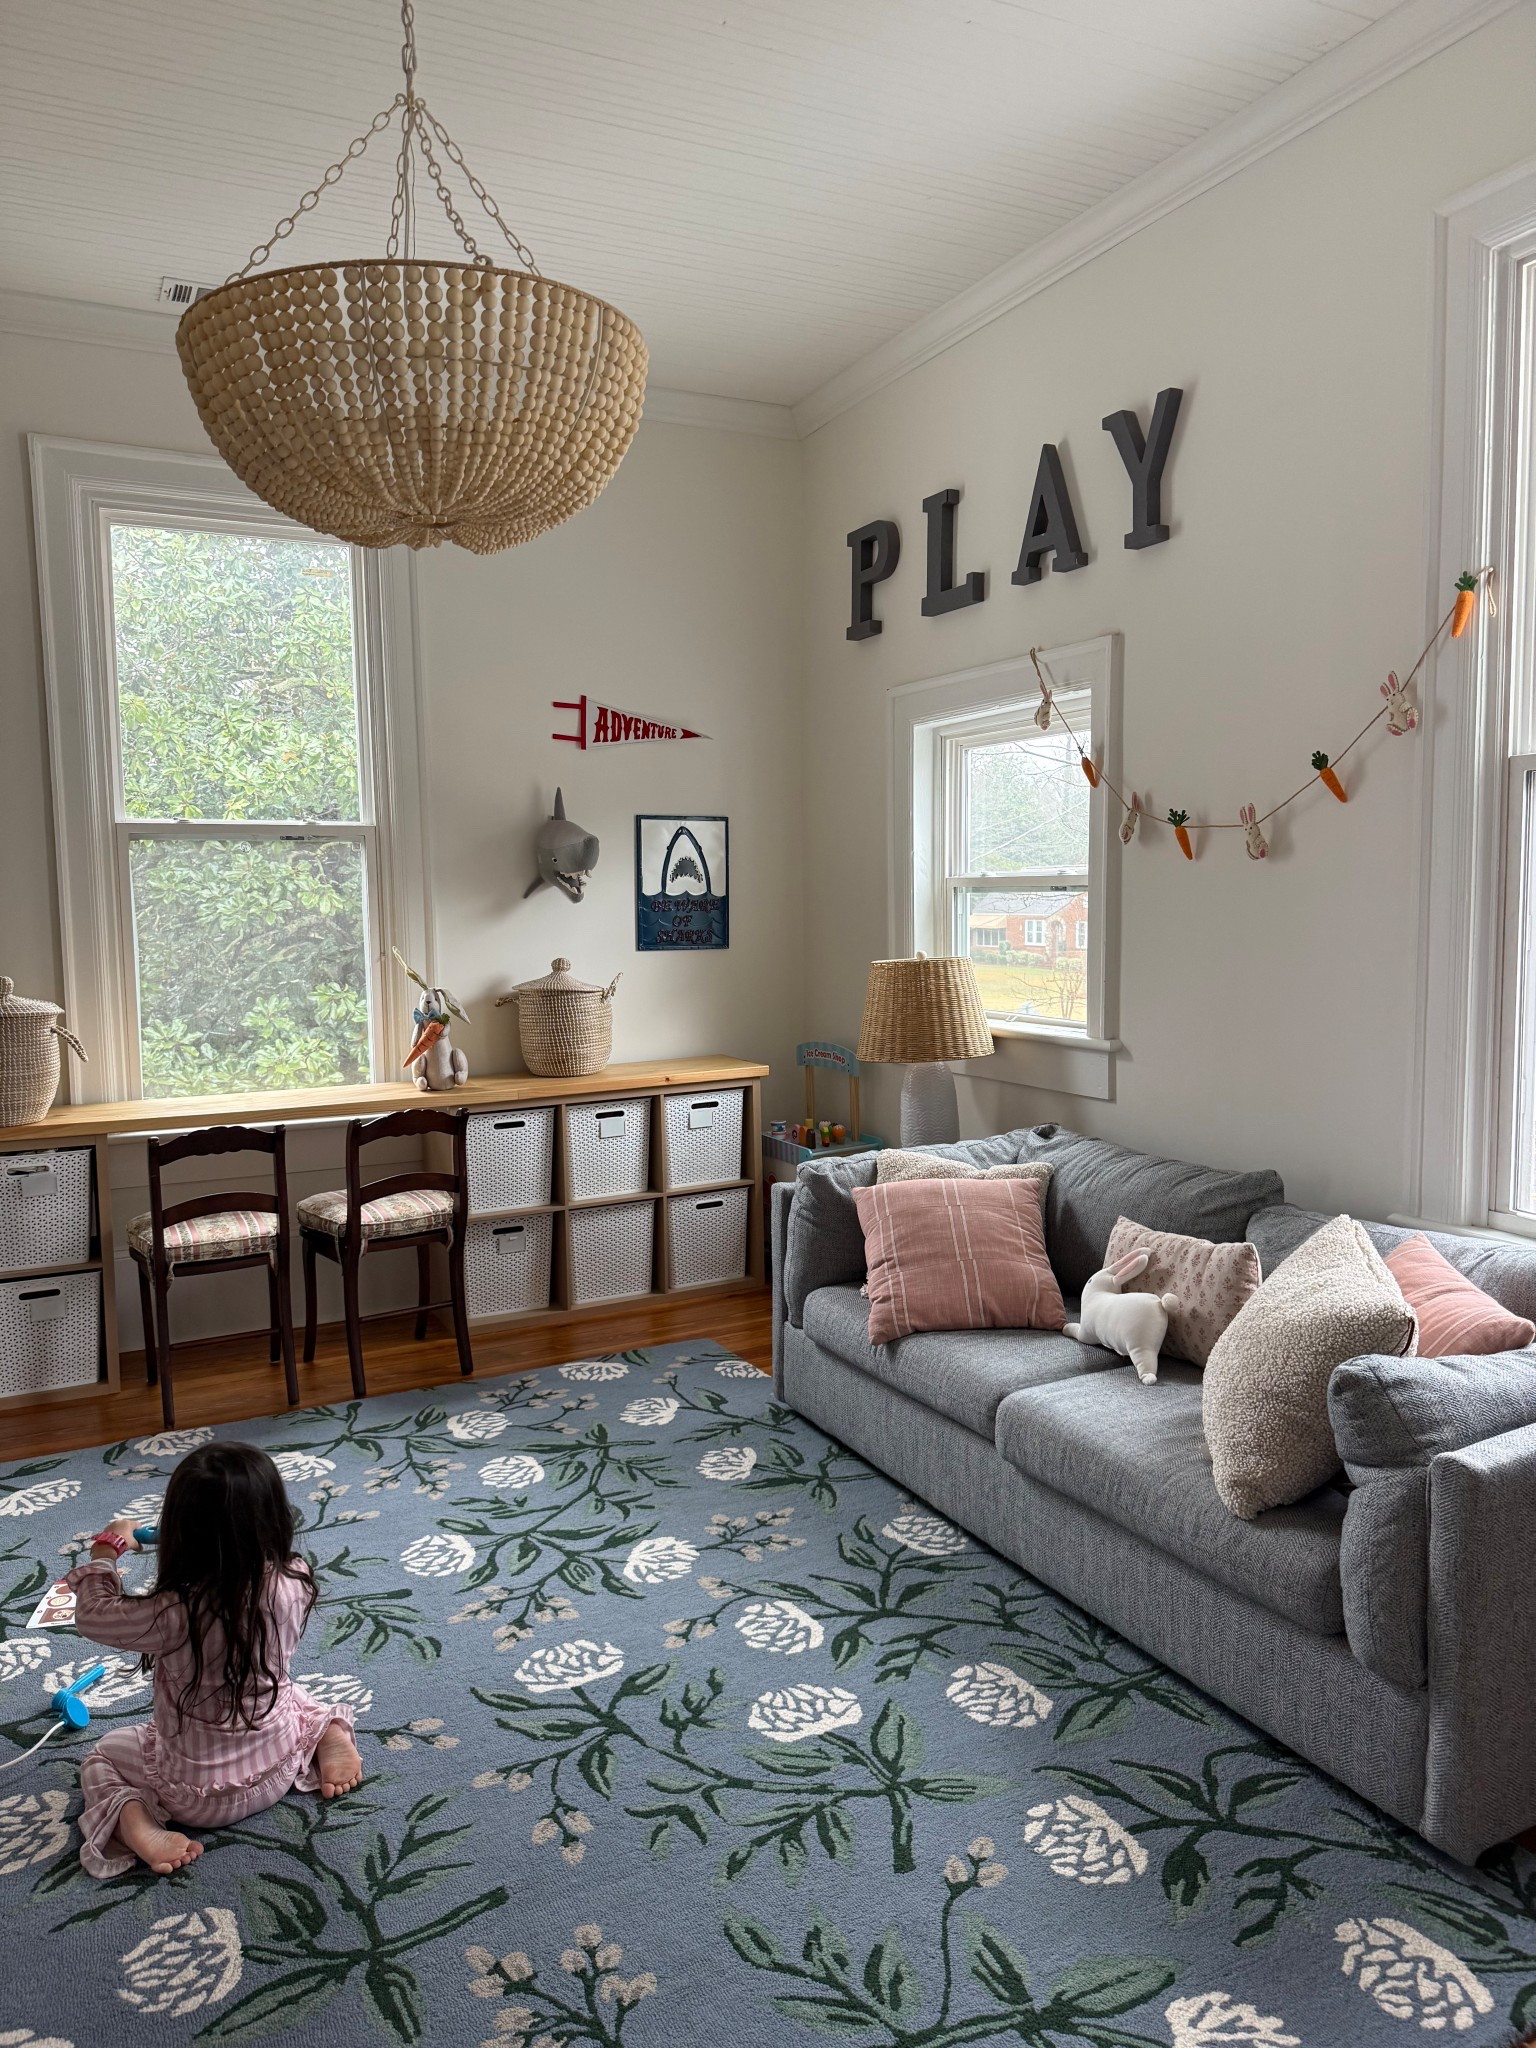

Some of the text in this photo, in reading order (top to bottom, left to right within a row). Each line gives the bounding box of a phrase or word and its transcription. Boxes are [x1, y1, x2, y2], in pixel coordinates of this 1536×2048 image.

[846, 387, 1183, 641] PLAY
[593, 706, 677, 743] ADVENTURE
[672, 915, 693, 928] OF
[656, 928, 714, 945] SHARKS
[805, 1048, 846, 1065] Ice Cream Shop
